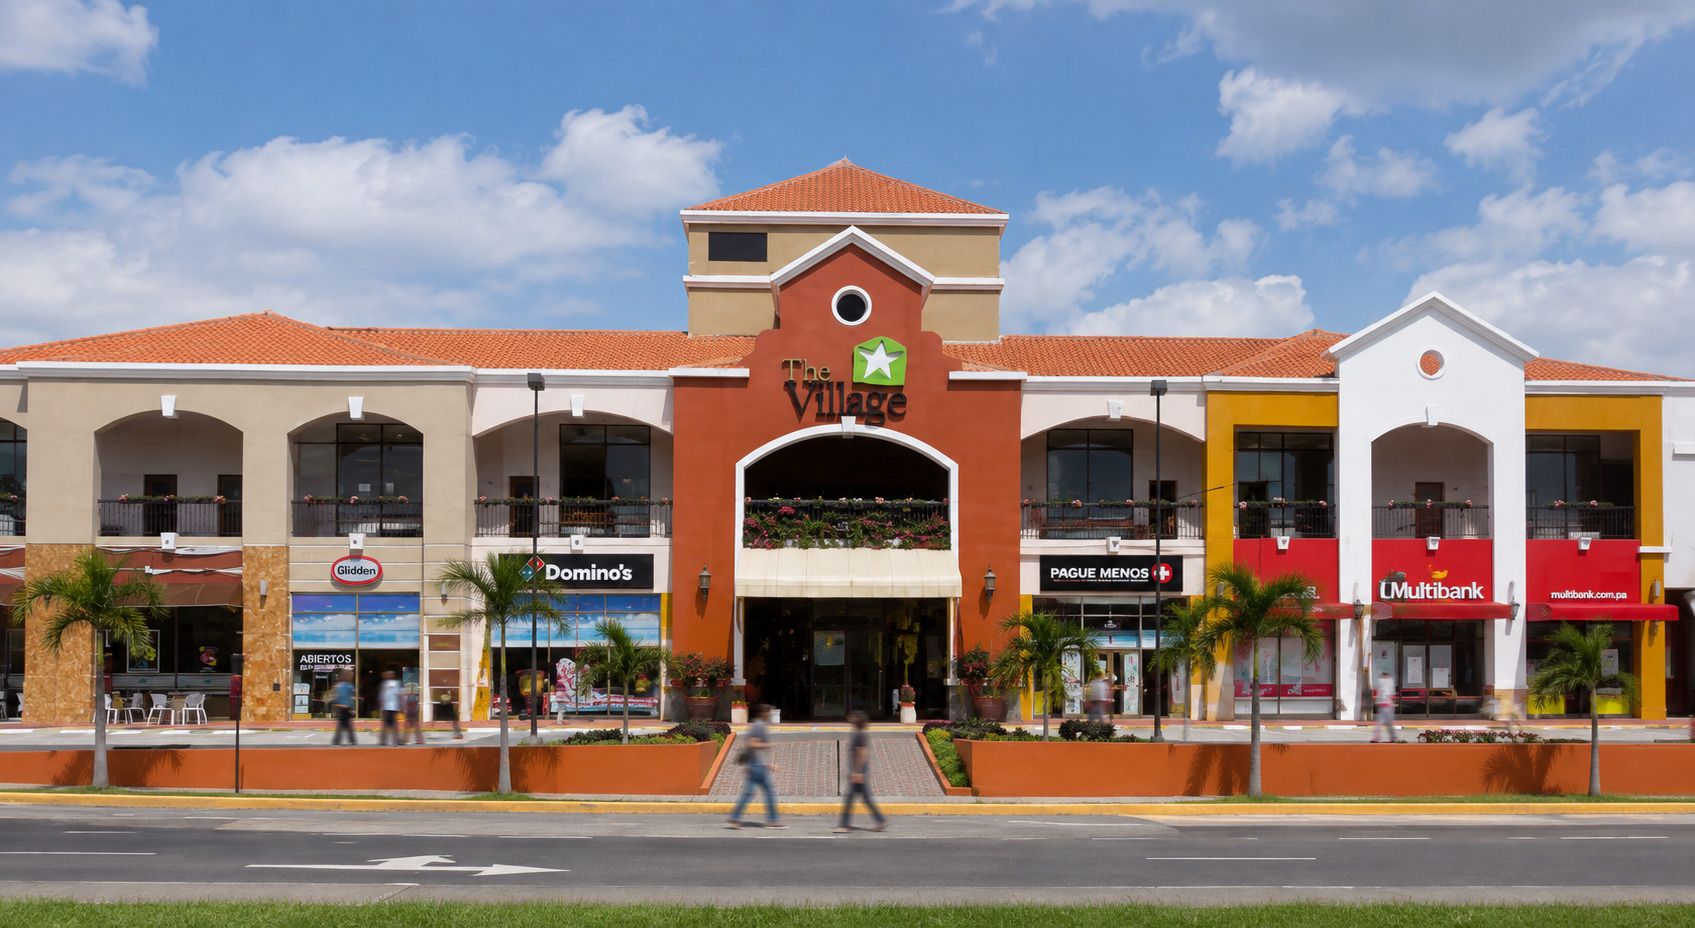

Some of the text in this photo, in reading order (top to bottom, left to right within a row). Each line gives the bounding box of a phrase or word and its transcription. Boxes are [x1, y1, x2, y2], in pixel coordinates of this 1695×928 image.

[782, 358, 831, 381] The
[784, 381, 908, 427] Village
[337, 565, 377, 576] Glidden
[545, 563, 633, 582] Domino's
[1050, 567, 1149, 579] PAGUE MENOS
[1550, 589, 1628, 601] multibank.com.pa
[299, 654, 352, 664] ABIERTOS
